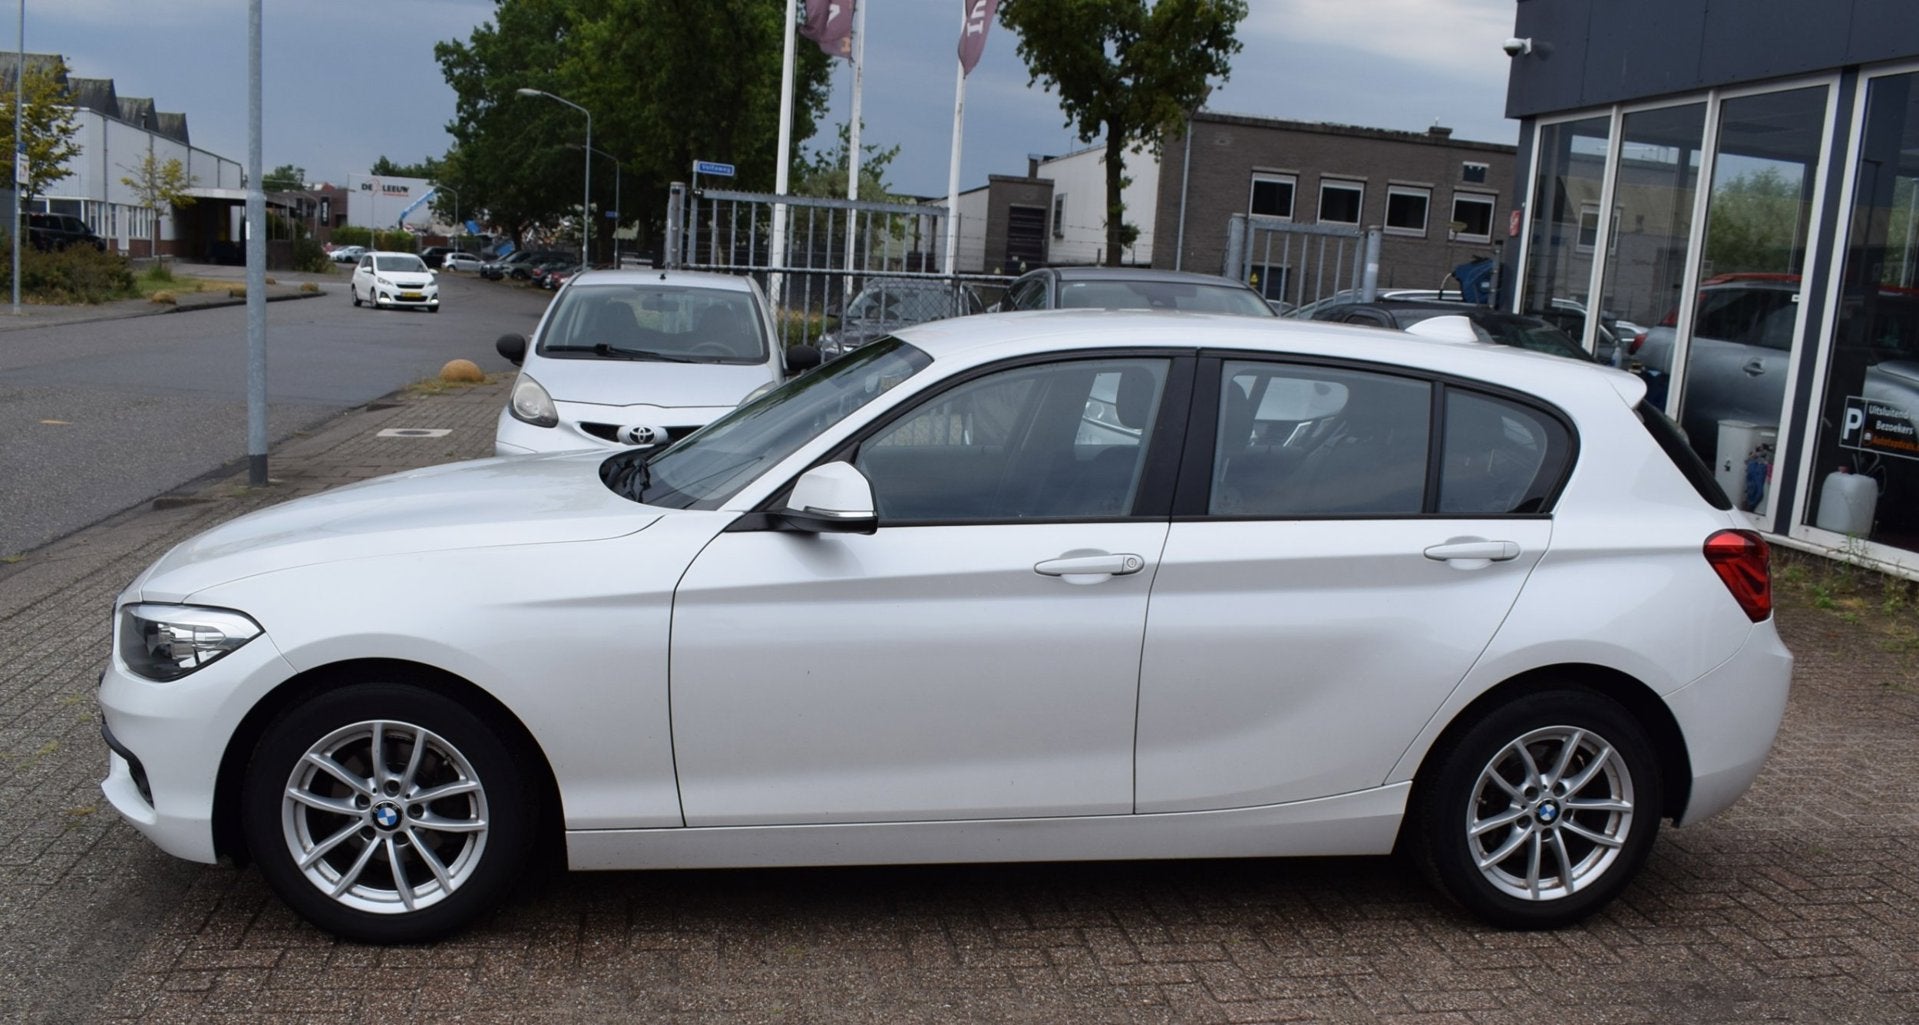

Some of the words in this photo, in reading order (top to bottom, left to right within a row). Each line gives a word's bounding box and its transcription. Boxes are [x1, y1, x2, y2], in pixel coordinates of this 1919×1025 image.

[361, 183, 373, 191] DE
[382, 184, 410, 192] LEEUW
[1843, 407, 1863, 440] P
[1876, 420, 1913, 435] Bezoekers
